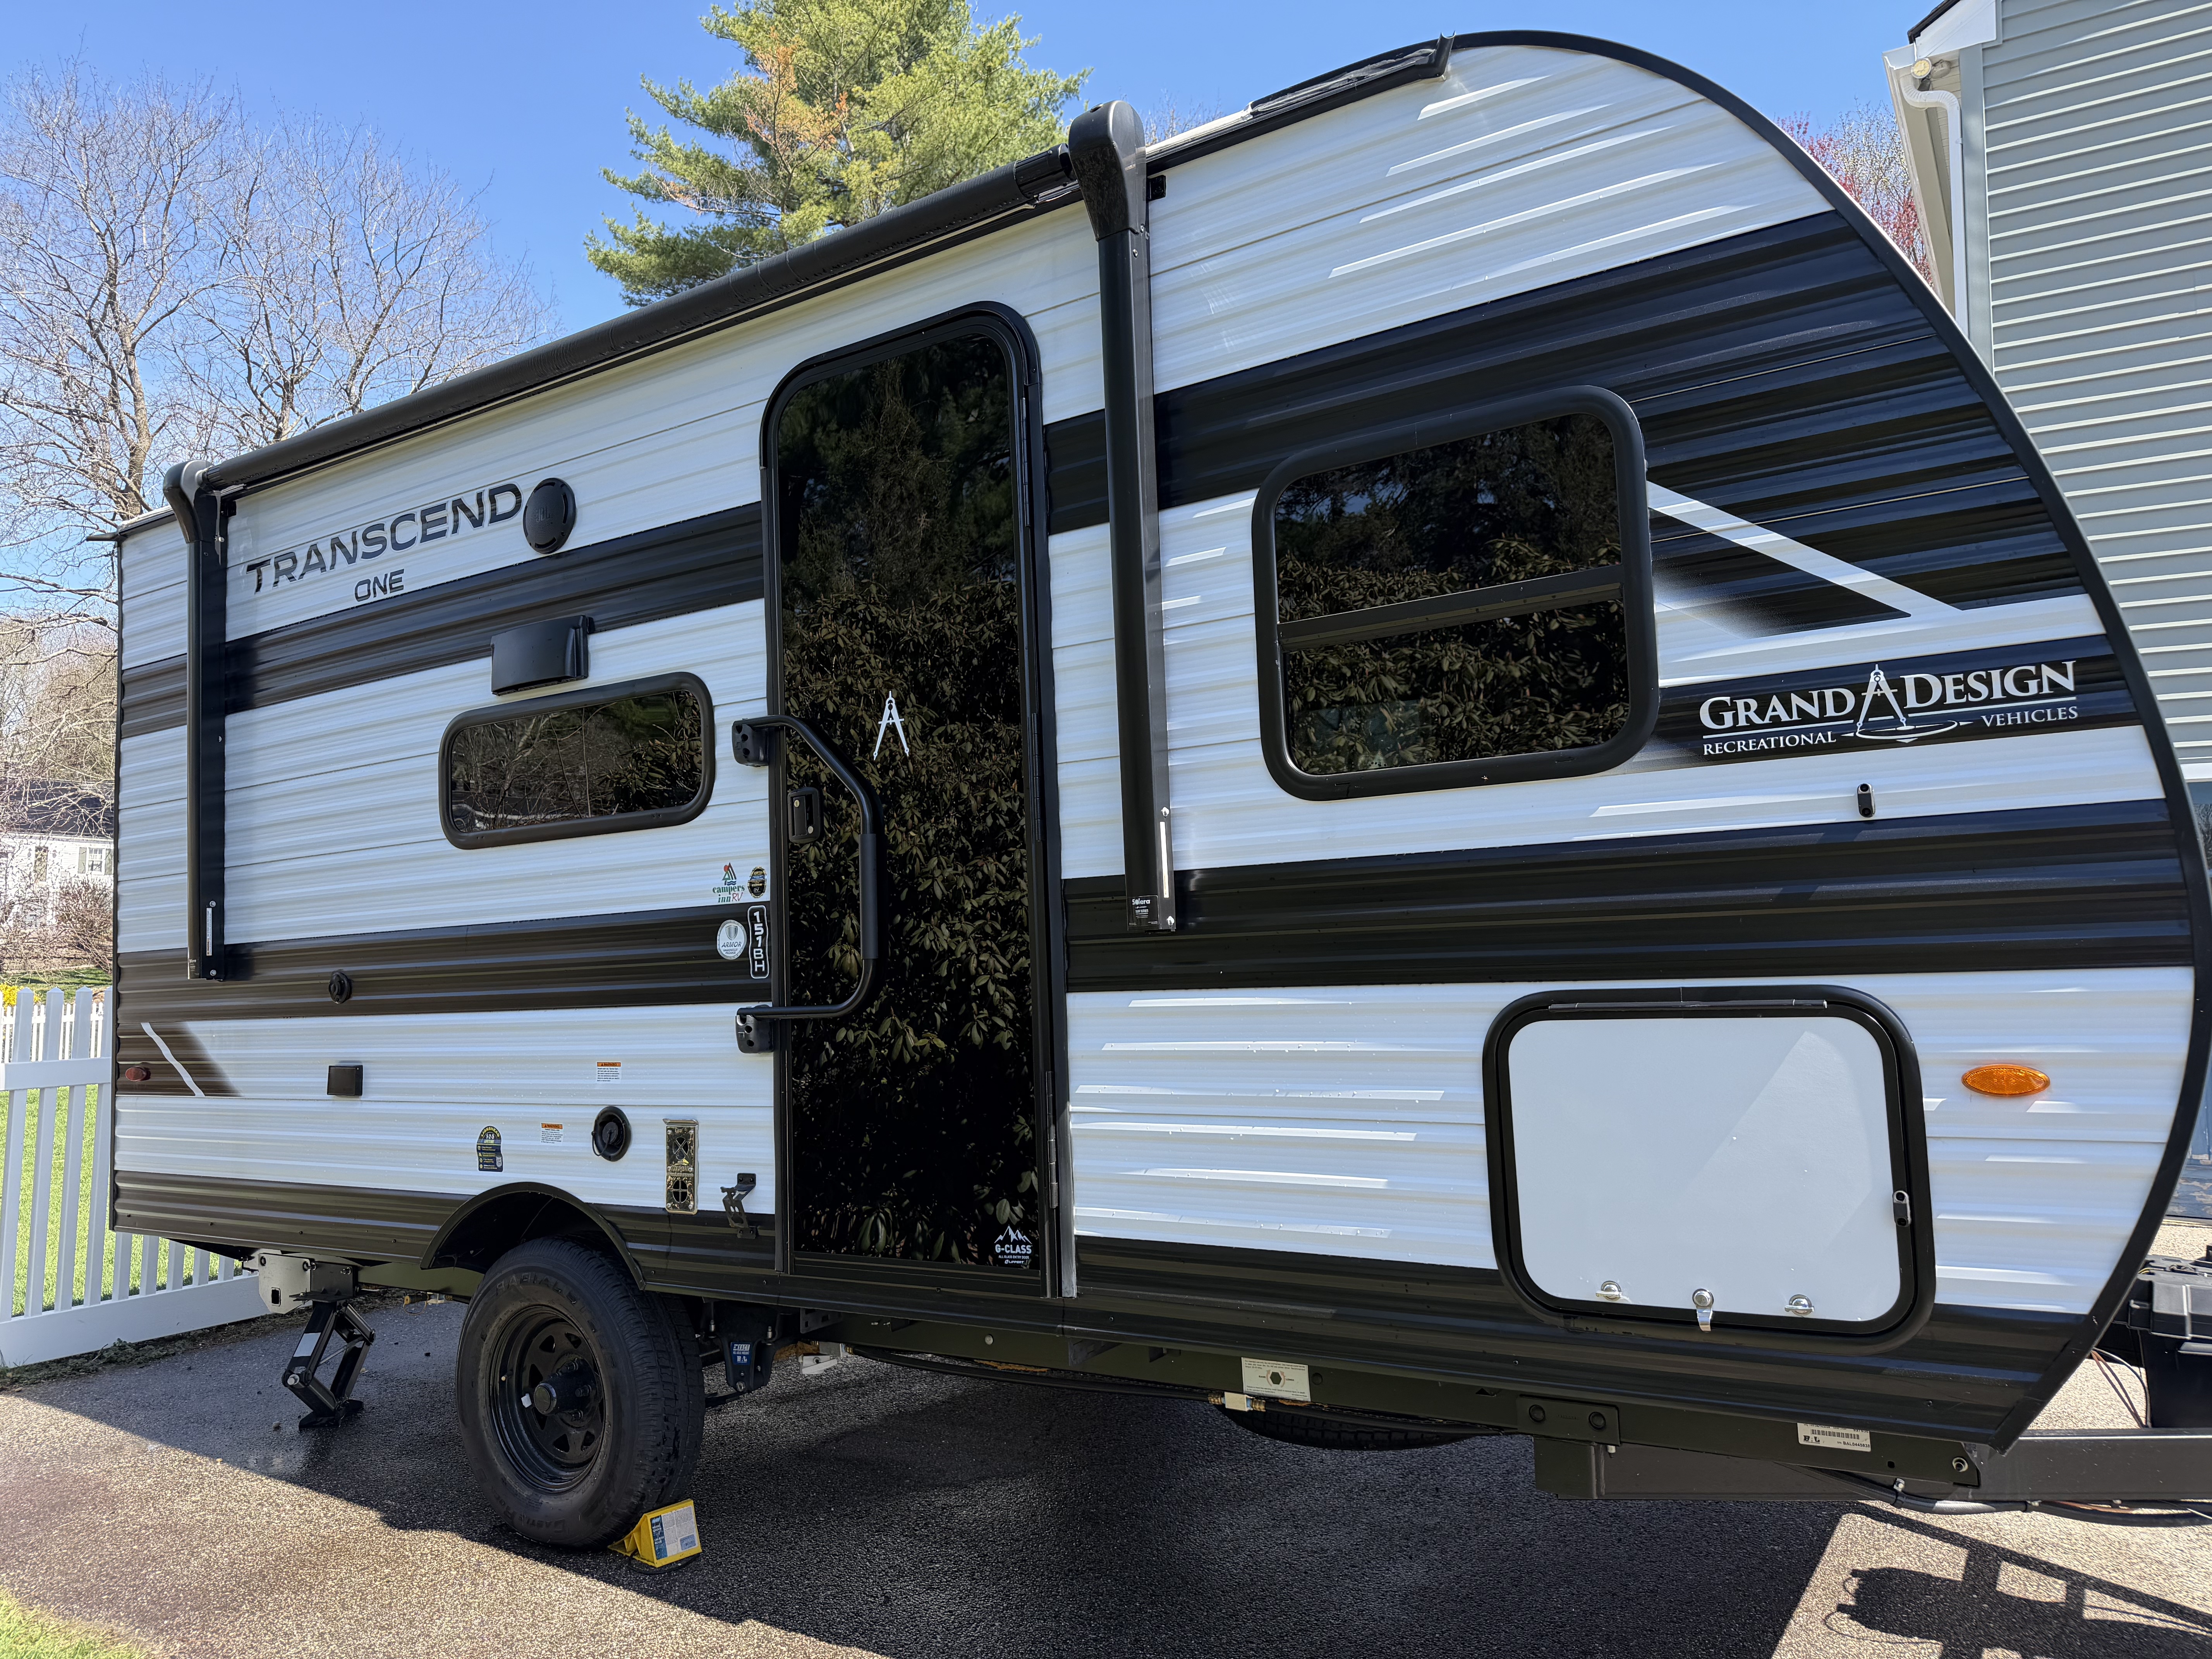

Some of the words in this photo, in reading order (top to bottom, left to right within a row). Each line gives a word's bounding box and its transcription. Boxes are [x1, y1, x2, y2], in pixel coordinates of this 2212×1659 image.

[246, 483, 522, 594] TRANSCEND
[354, 568, 405, 602] ONE
[1699, 688, 1855, 730] GRAND
[1900, 661, 2077, 709] DESIGN
[1703, 731, 1836, 756] RECREATIONAL
[1981, 706, 2078, 727] VEHICLES
[713, 883, 745, 895] campers
[718, 894, 731, 903] inn
[732, 892, 743, 902] RV
[754, 911, 765, 972] 151BH
[995, 1244, 1032, 1254] G-CLASS
